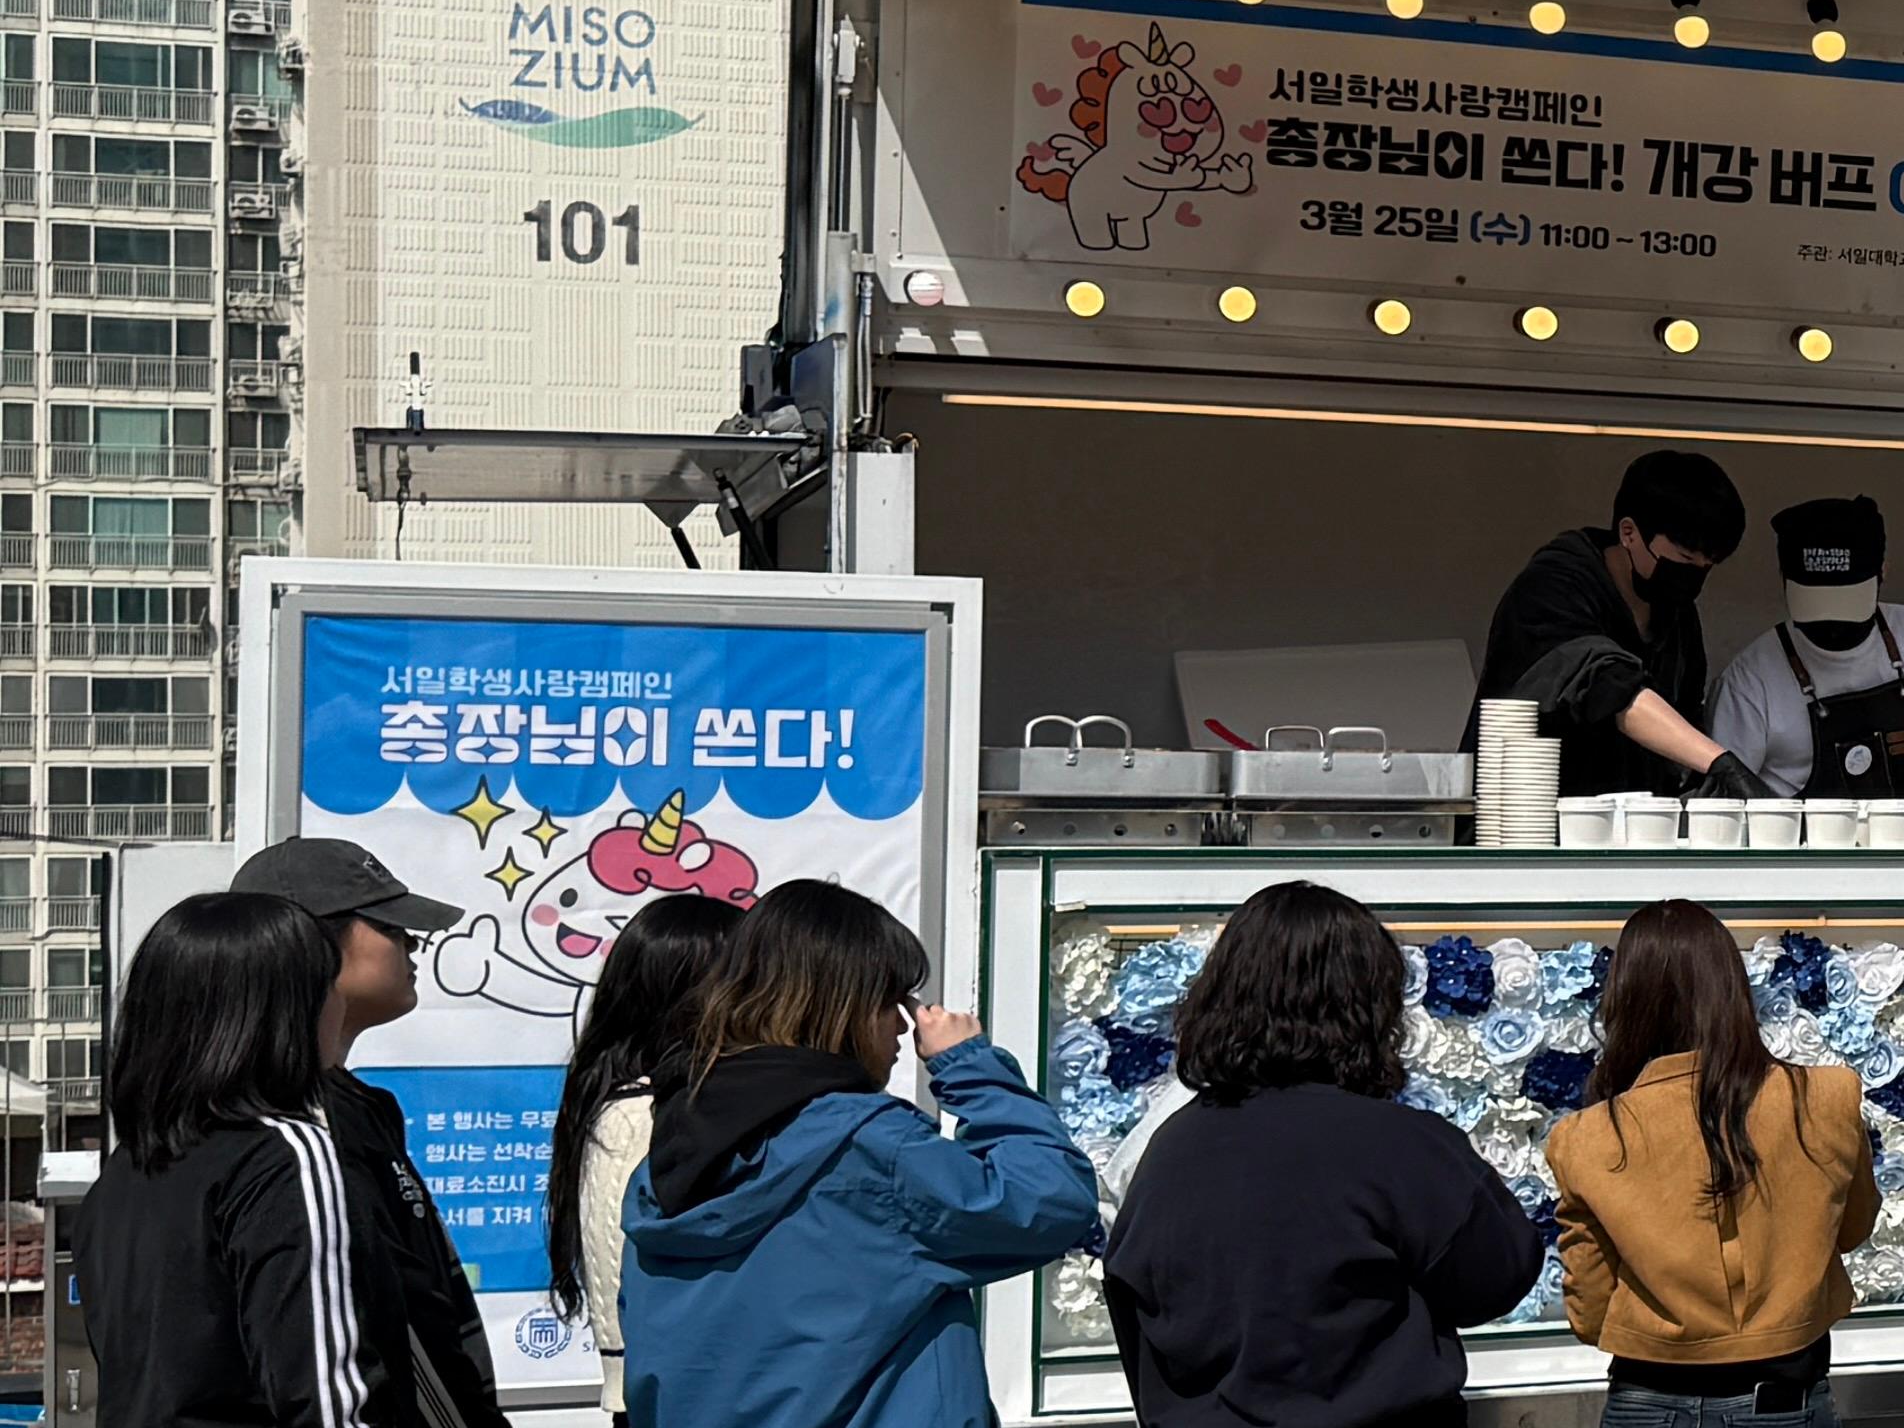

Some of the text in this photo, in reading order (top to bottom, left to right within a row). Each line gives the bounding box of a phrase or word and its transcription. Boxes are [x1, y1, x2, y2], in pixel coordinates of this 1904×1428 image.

[508, 2, 655, 48] MISO
[509, 49, 656, 95] ZIUM
[1269, 68, 1602, 127] 서일학생사랑캠페인
[1266, 117, 1484, 181] 총장님이
[1501, 136, 1625, 192] 쏜다!
[1643, 138, 1759, 203] 개강
[1770, 149, 1877, 211] 버프
[524, 199, 639, 265] 101
[1300, 199, 1363, 237] 3월
[1373, 205, 1458, 243] 25일
[1470, 210, 1531, 246] (수)
[1540, 224, 1609, 250] 11:00
[1639, 230, 1717, 257] 13:00
[1797, 244, 1833, 262] 주관:
[381, 666, 673, 700] 서일학생사랑캠페인
[379, 700, 855, 770] 총장님이 쏜다!
[427, 1112, 446, 1131] 본
[453, 1111, 513, 1131] 행사는
[426, 1143, 487, 1163] 행사는
[492, 1206, 532, 1225] 지켜
